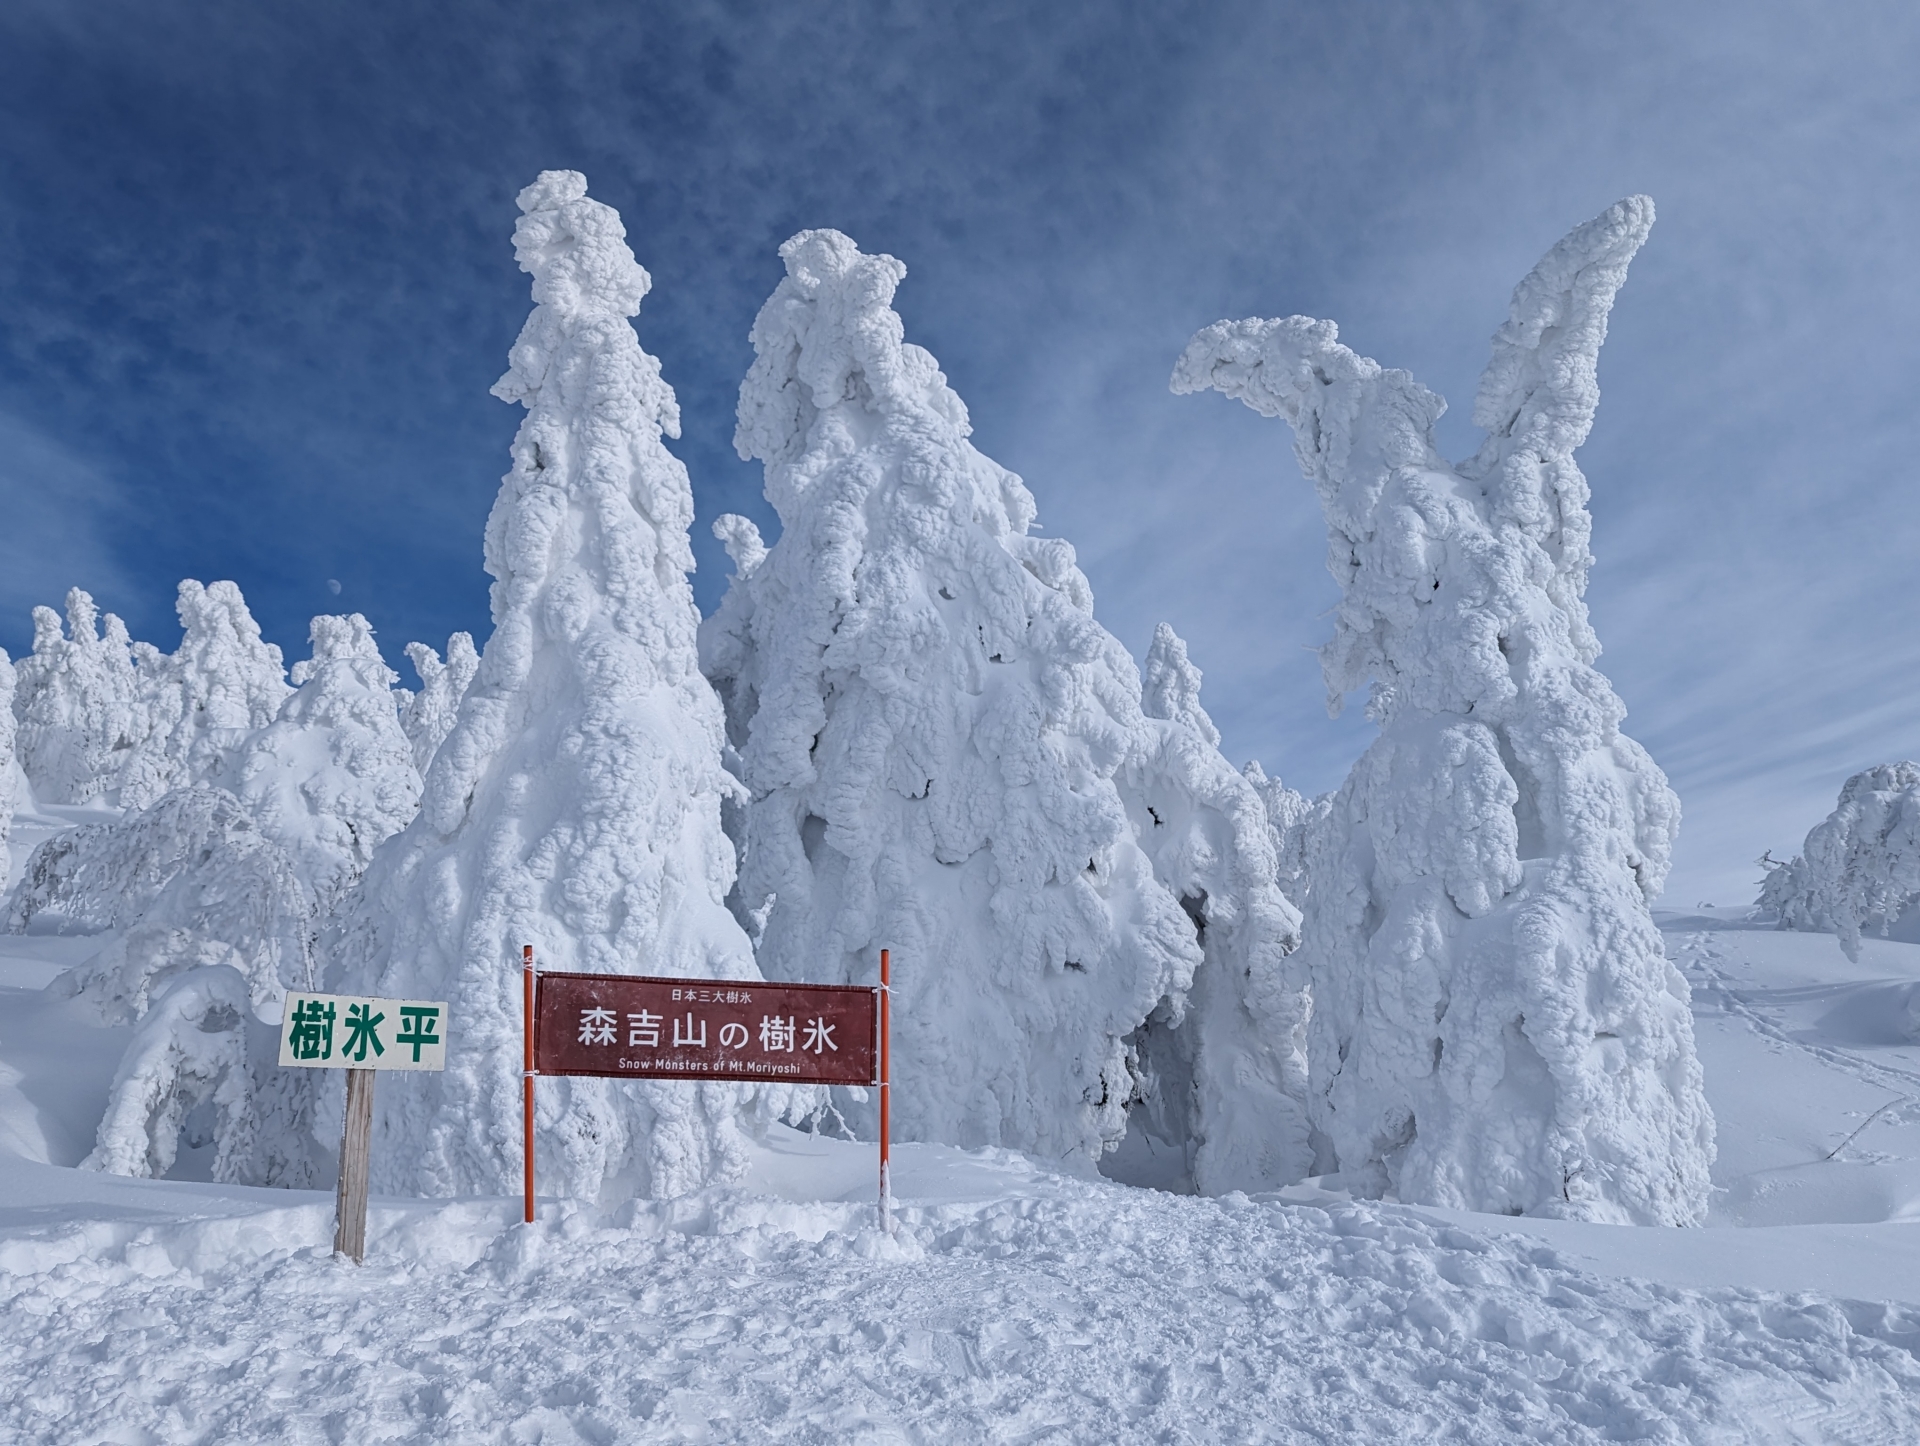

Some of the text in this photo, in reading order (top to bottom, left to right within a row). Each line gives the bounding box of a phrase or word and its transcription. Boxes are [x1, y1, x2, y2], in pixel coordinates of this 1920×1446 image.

[671, 988, 752, 1004] 日本三大樹氷
[289, 1000, 439, 1062] 樹氷平
[577, 1006, 839, 1055] 森吉山の樹氷
[618, 1057, 650, 1069] Snow
[655, 1058, 709, 1071] Monsters
[713, 1060, 725, 1071] of
